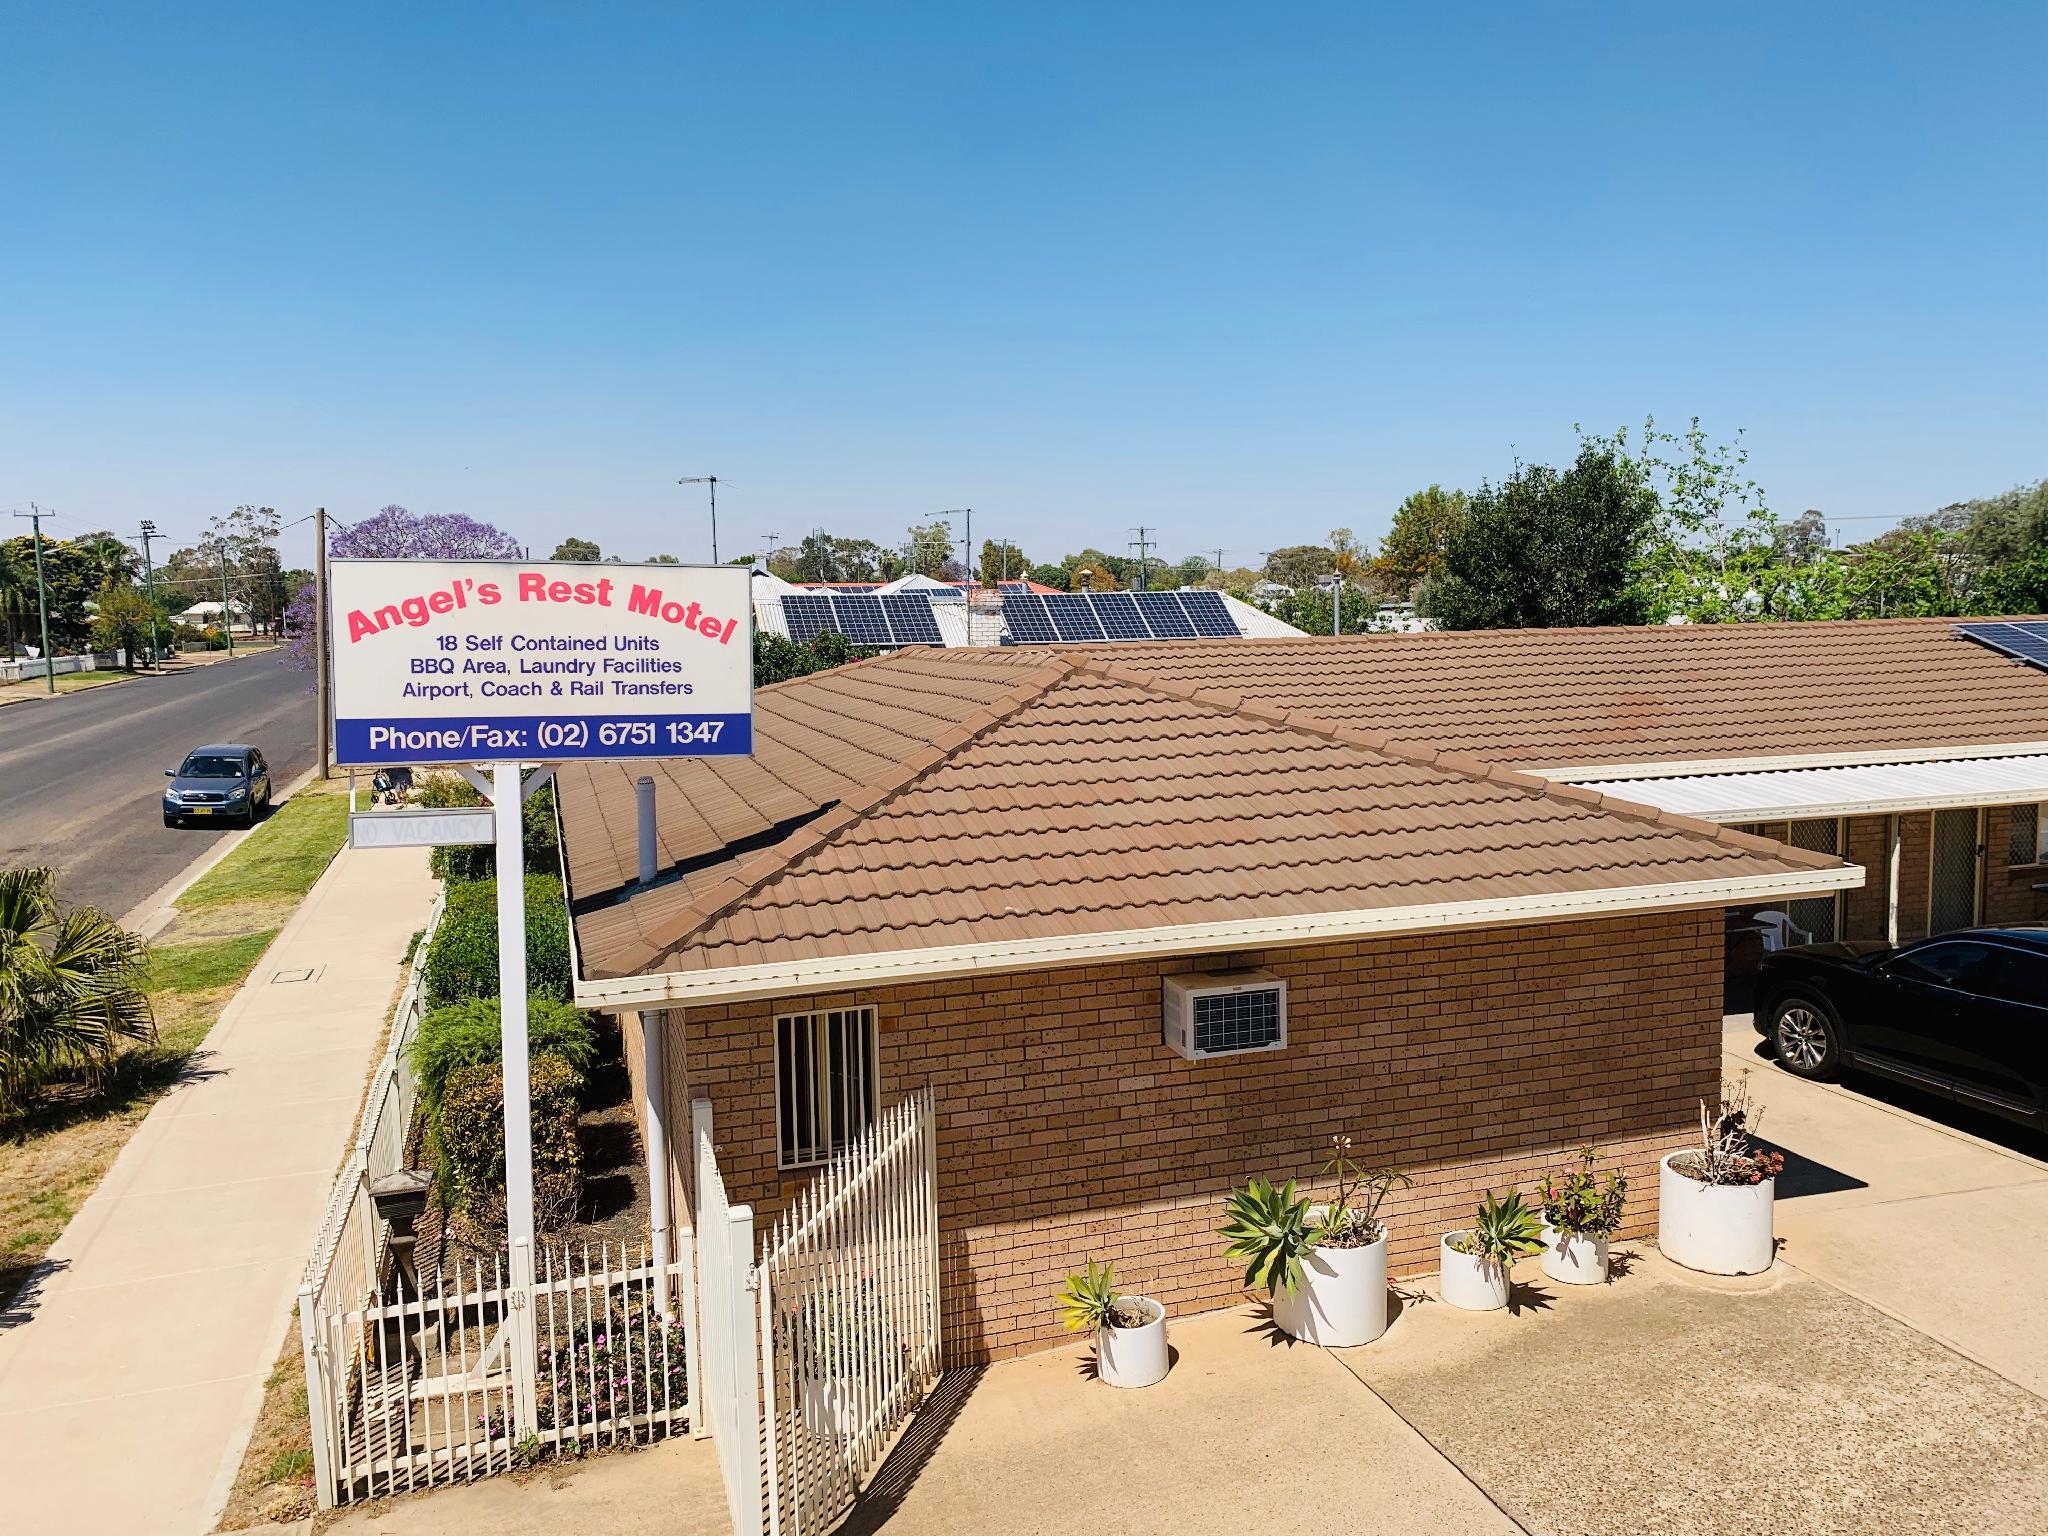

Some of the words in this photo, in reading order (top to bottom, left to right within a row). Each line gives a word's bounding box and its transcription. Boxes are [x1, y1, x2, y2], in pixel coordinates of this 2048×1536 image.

[348, 577, 503, 644] Angel's
[518, 572, 614, 608] Rest
[627, 583, 738, 646] Motel
[437, 635, 458, 651] 18
[466, 635, 504, 651] Self
[511, 635, 607, 651] Contained
[615, 635, 660, 651] Units
[411, 658, 455, 674] BBQ
[463, 658, 511, 677] Area,
[520, 658, 596, 677] Laundry
[604, 657, 683, 674] Facilities
[403, 682, 473, 701] Airport,
[481, 681, 543, 697] Coach
[551, 681, 563, 696] &
[571, 681, 604, 696] Rail
[611, 681, 694, 696] Transfers
[370, 725, 527, 750] Phone/Fax:
[537, 721, 589, 749] (02)
[599, 722, 656, 746] 6751
[666, 721, 725, 744] 1347
[391, 818, 483, 843] VACANCY
